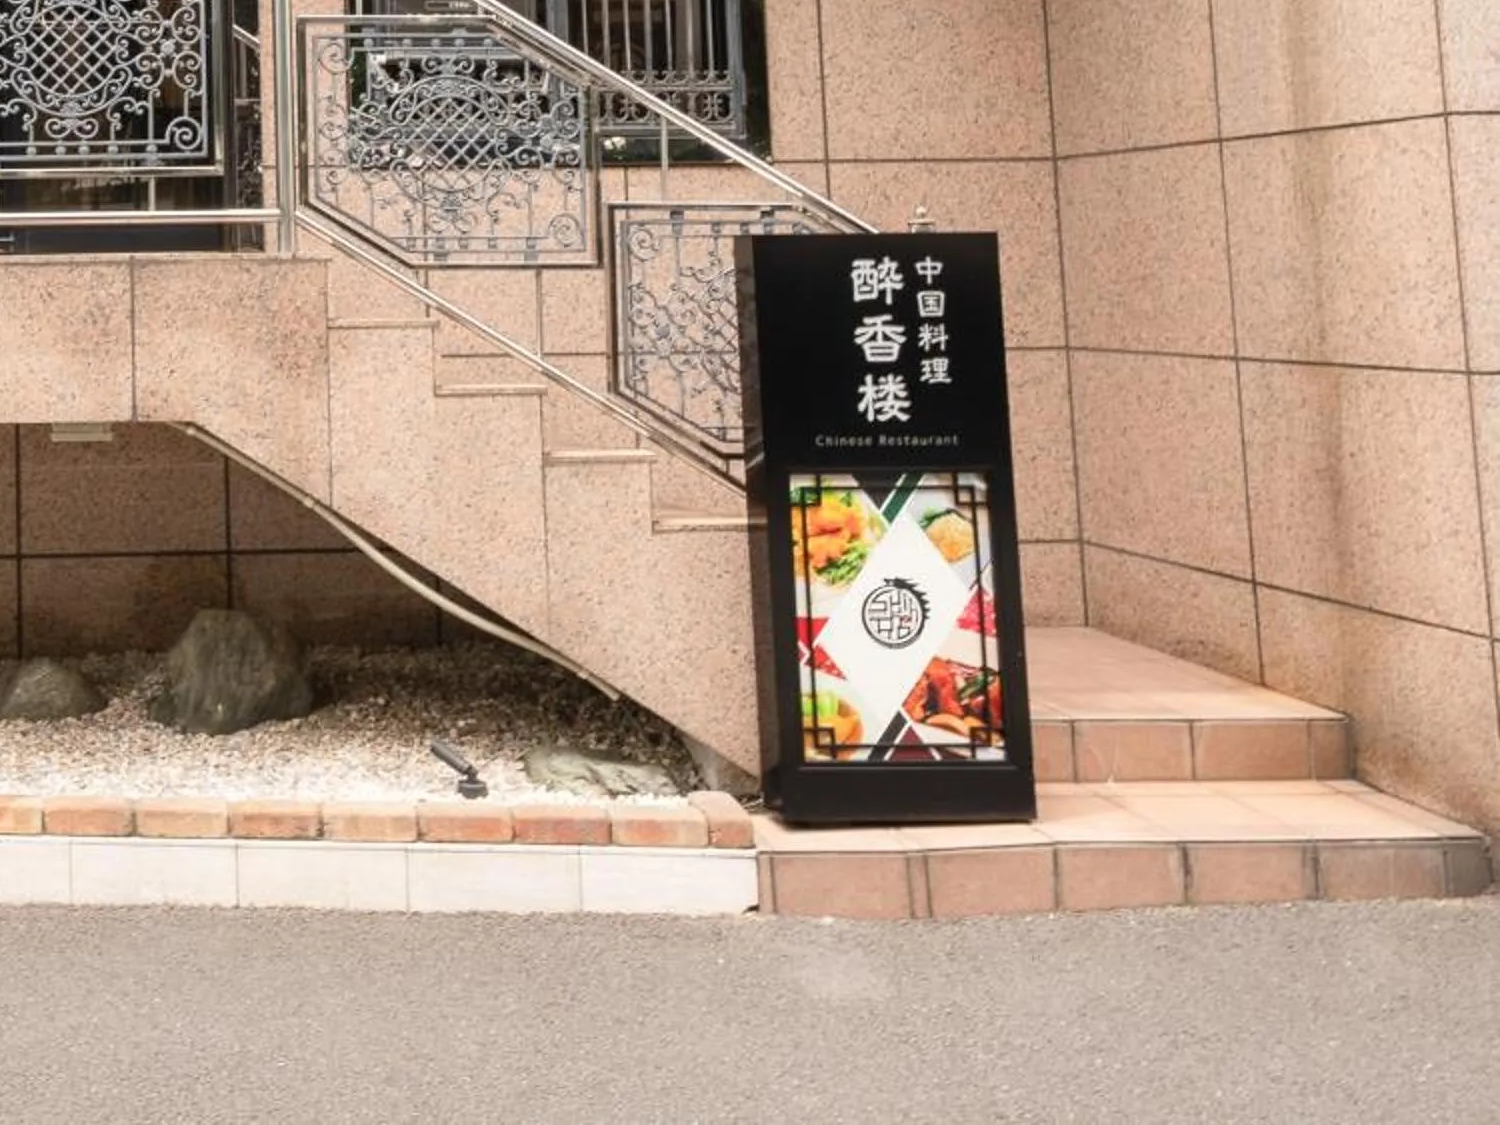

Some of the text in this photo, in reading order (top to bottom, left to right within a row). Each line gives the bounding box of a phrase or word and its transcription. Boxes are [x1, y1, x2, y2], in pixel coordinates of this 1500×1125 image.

[851, 256, 912, 422] 酔香楼
[914, 256, 952, 384] 中国料理
[815, 434, 958, 448] Chinese Restaurant
